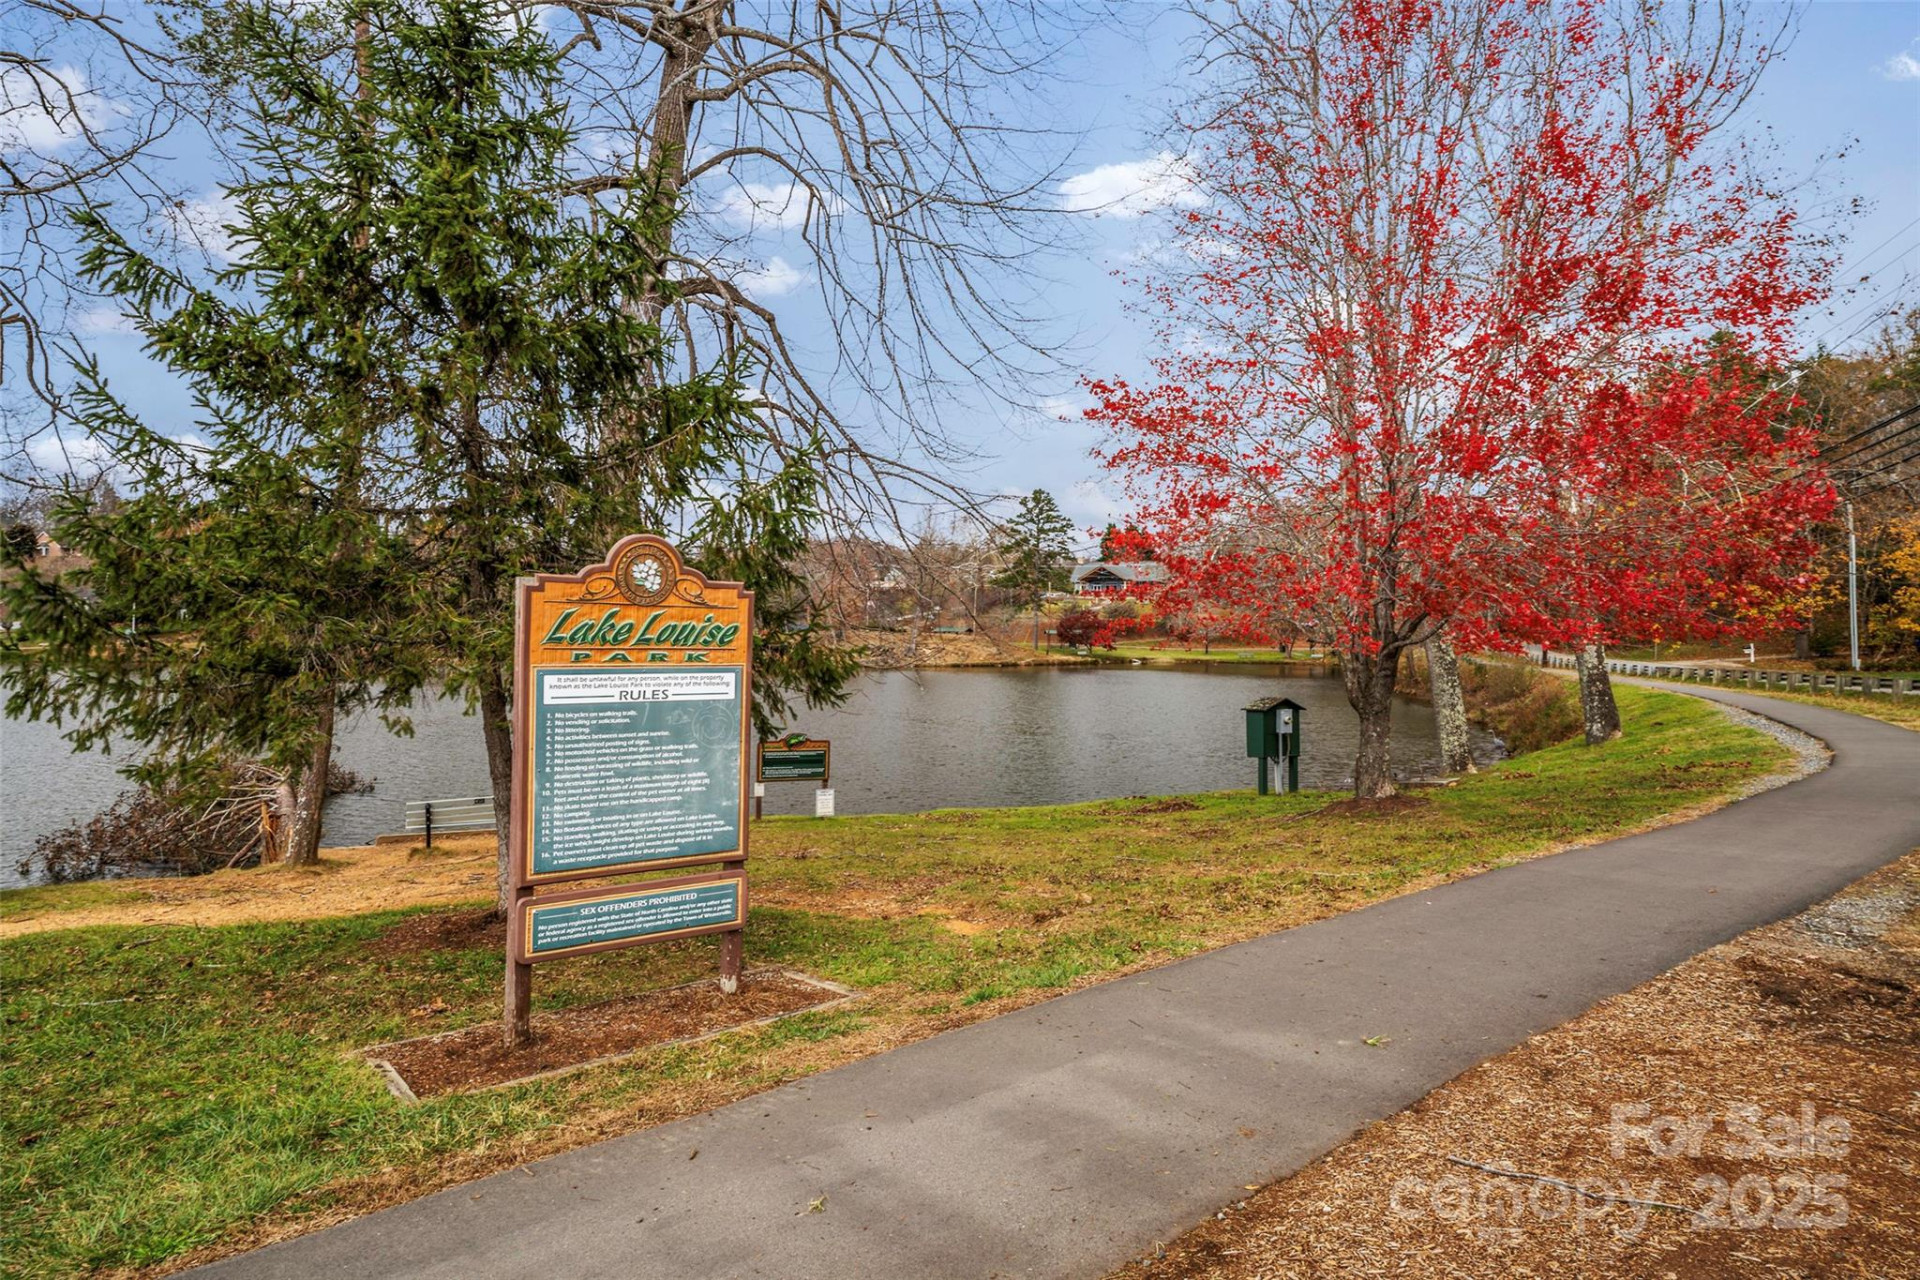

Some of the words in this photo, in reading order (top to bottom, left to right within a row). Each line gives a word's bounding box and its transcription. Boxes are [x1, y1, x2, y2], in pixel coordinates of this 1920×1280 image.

[542, 607, 634, 646] Lake
[630, 610, 740, 647] Louise
[570, 650, 710, 662] PARK
[619, 689, 669, 701] RULES
[580, 907, 596, 915] SEX
[597, 900, 647, 913] OFFENDERS
[649, 893, 697, 906] PROHIBITED
